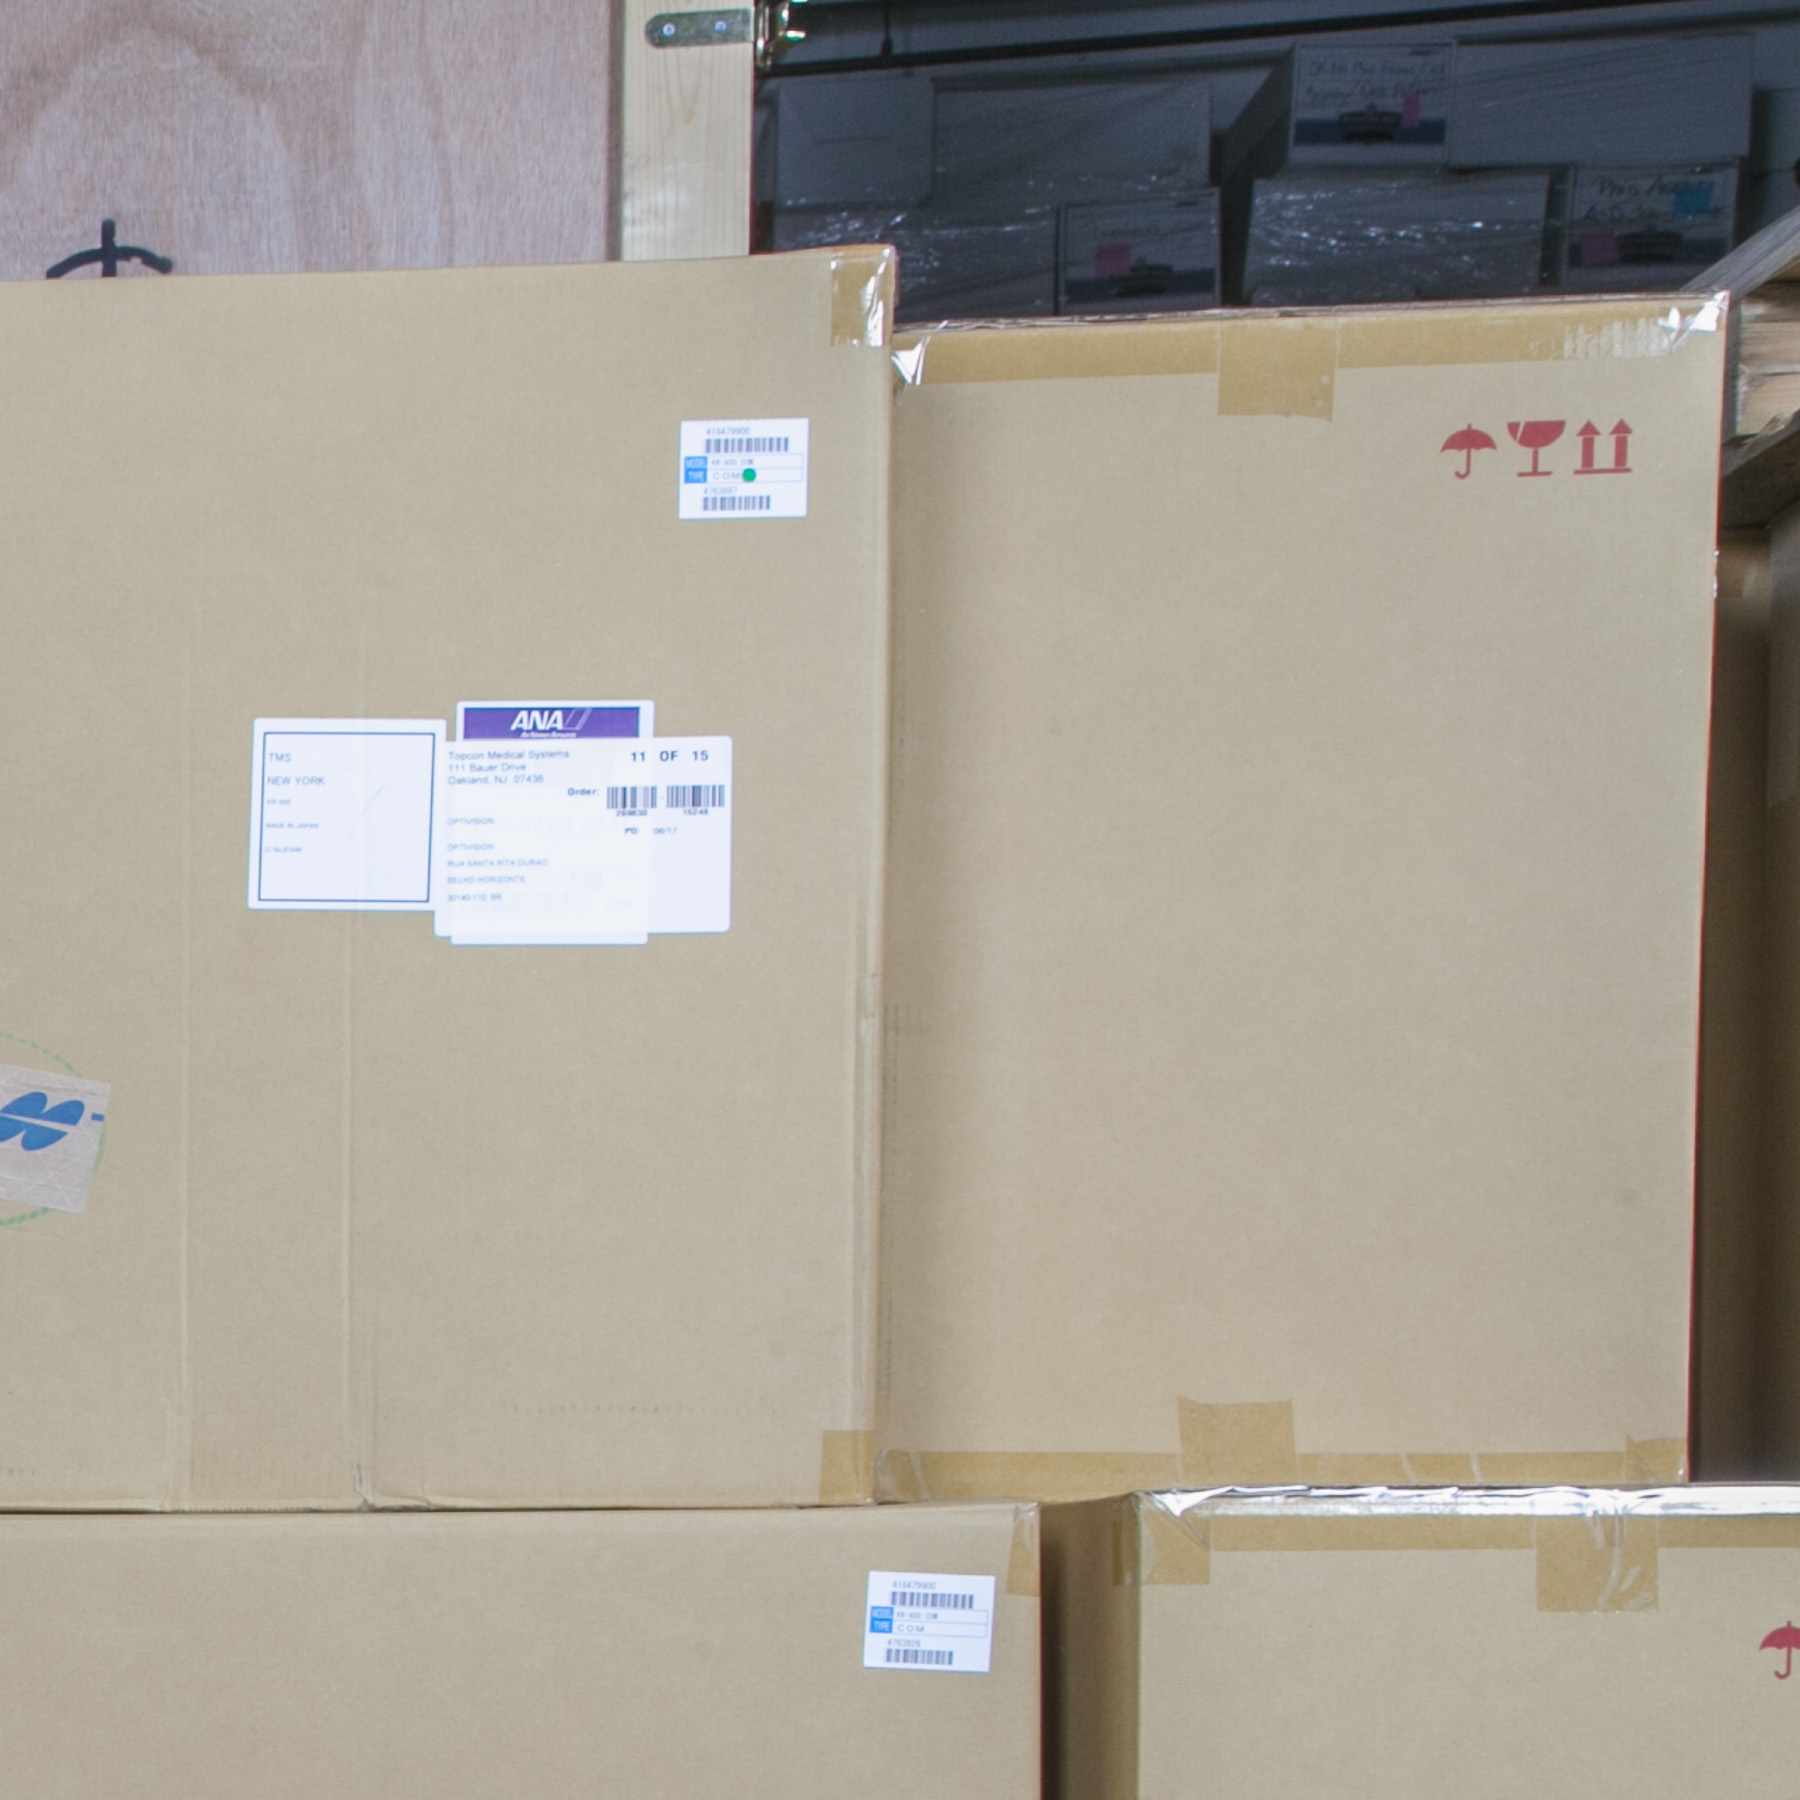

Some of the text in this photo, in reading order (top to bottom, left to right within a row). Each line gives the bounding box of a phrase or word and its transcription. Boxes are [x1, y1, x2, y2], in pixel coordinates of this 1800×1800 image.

[510, 710, 563, 730] ANA
[269, 753, 292, 762] TMS
[448, 749, 708, 761] Topcon Medical Systems 11 OF 15
[448, 762, 526, 772] 111 Bauer Drive
[267, 777, 325, 785] NEW YORK
[495, 775, 507, 784] NJ
[514, 774, 544, 783] 07436
